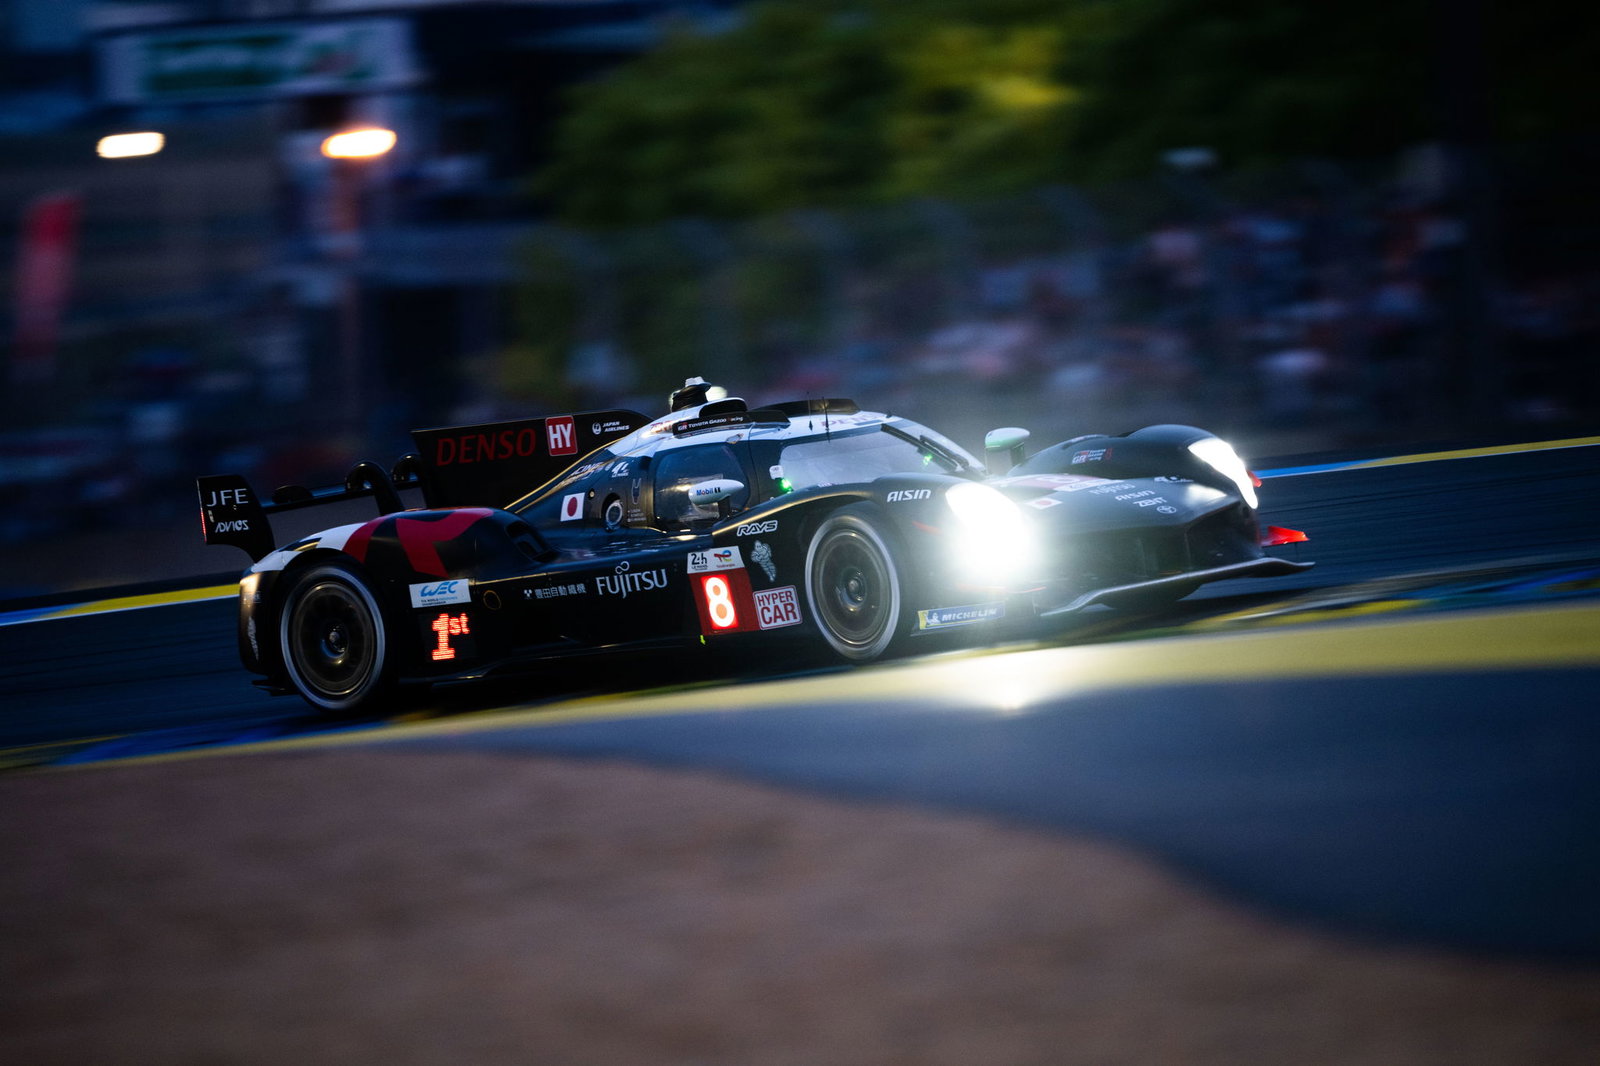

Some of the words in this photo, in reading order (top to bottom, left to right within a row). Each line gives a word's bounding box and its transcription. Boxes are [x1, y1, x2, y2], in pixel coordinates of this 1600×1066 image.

[548, 422, 572, 450] HY
[436, 428, 537, 467] DENSO
[206, 488, 249, 507] JFE
[697, 488, 713, 496] Mobil
[887, 489, 932, 503] AISIN
[1115, 490, 1156, 501] AISIN
[1133, 497, 1167, 507] ZENT
[215, 519, 249, 533] ADVICS
[736, 519, 779, 537] RAYS
[421, 581, 459, 597] WEC
[595, 568, 668, 600] FUJITSU
[704, 576, 736, 628] 8
[757, 590, 794, 607] HYPER
[761, 602, 798, 625] CAR
[942, 608, 998, 622] MICHELIN
[432, 612, 470, 661] 1st
